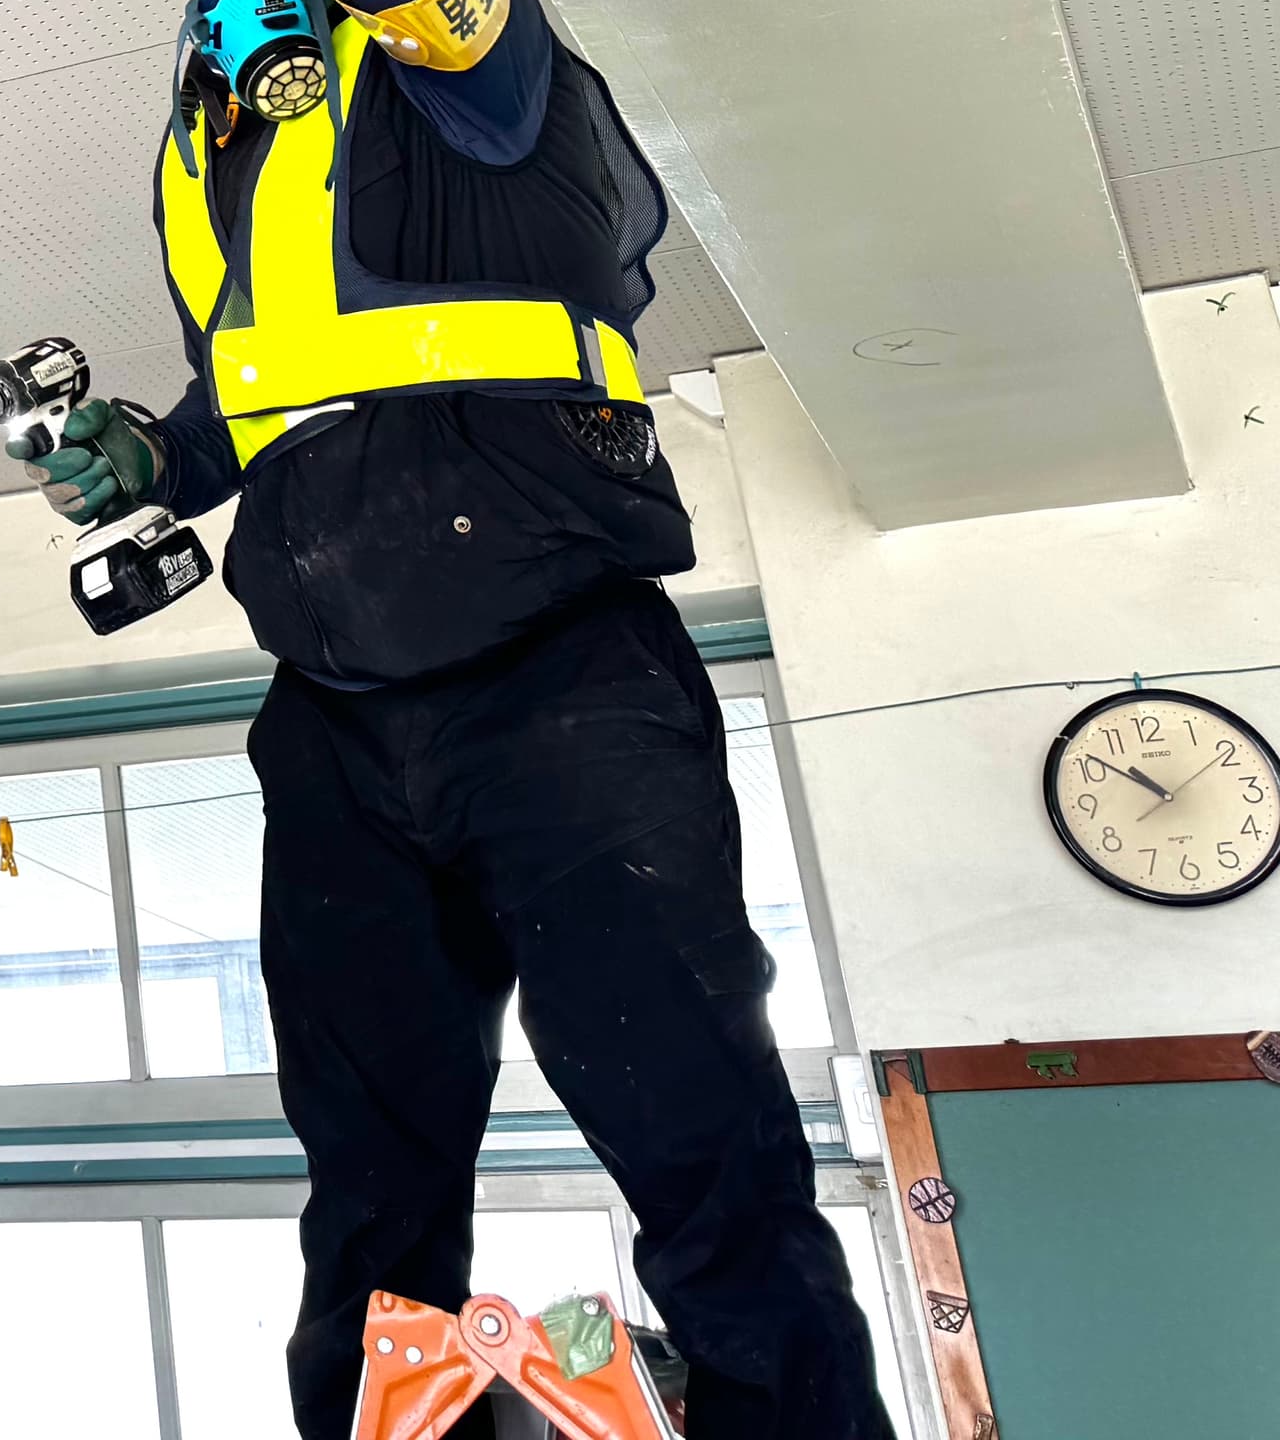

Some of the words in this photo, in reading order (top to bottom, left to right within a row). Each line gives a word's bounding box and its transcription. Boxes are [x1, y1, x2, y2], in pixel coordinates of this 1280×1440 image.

[1102, 729, 1126, 755] 11
[1131, 716, 1165, 744] 12
[1183, 720, 1197, 746] 1
[1215, 740, 1241, 767] 2
[1075, 758, 1106, 784] 10
[1238, 776, 1264, 804] 3
[1077, 794, 1098, 819] 9
[1102, 826, 1122, 853] 8
[1240, 814, 1262, 841] 4
[1138, 848, 1157, 876] 7
[1180, 854, 1200, 881] 6
[1217, 841, 1240, 869] 5
